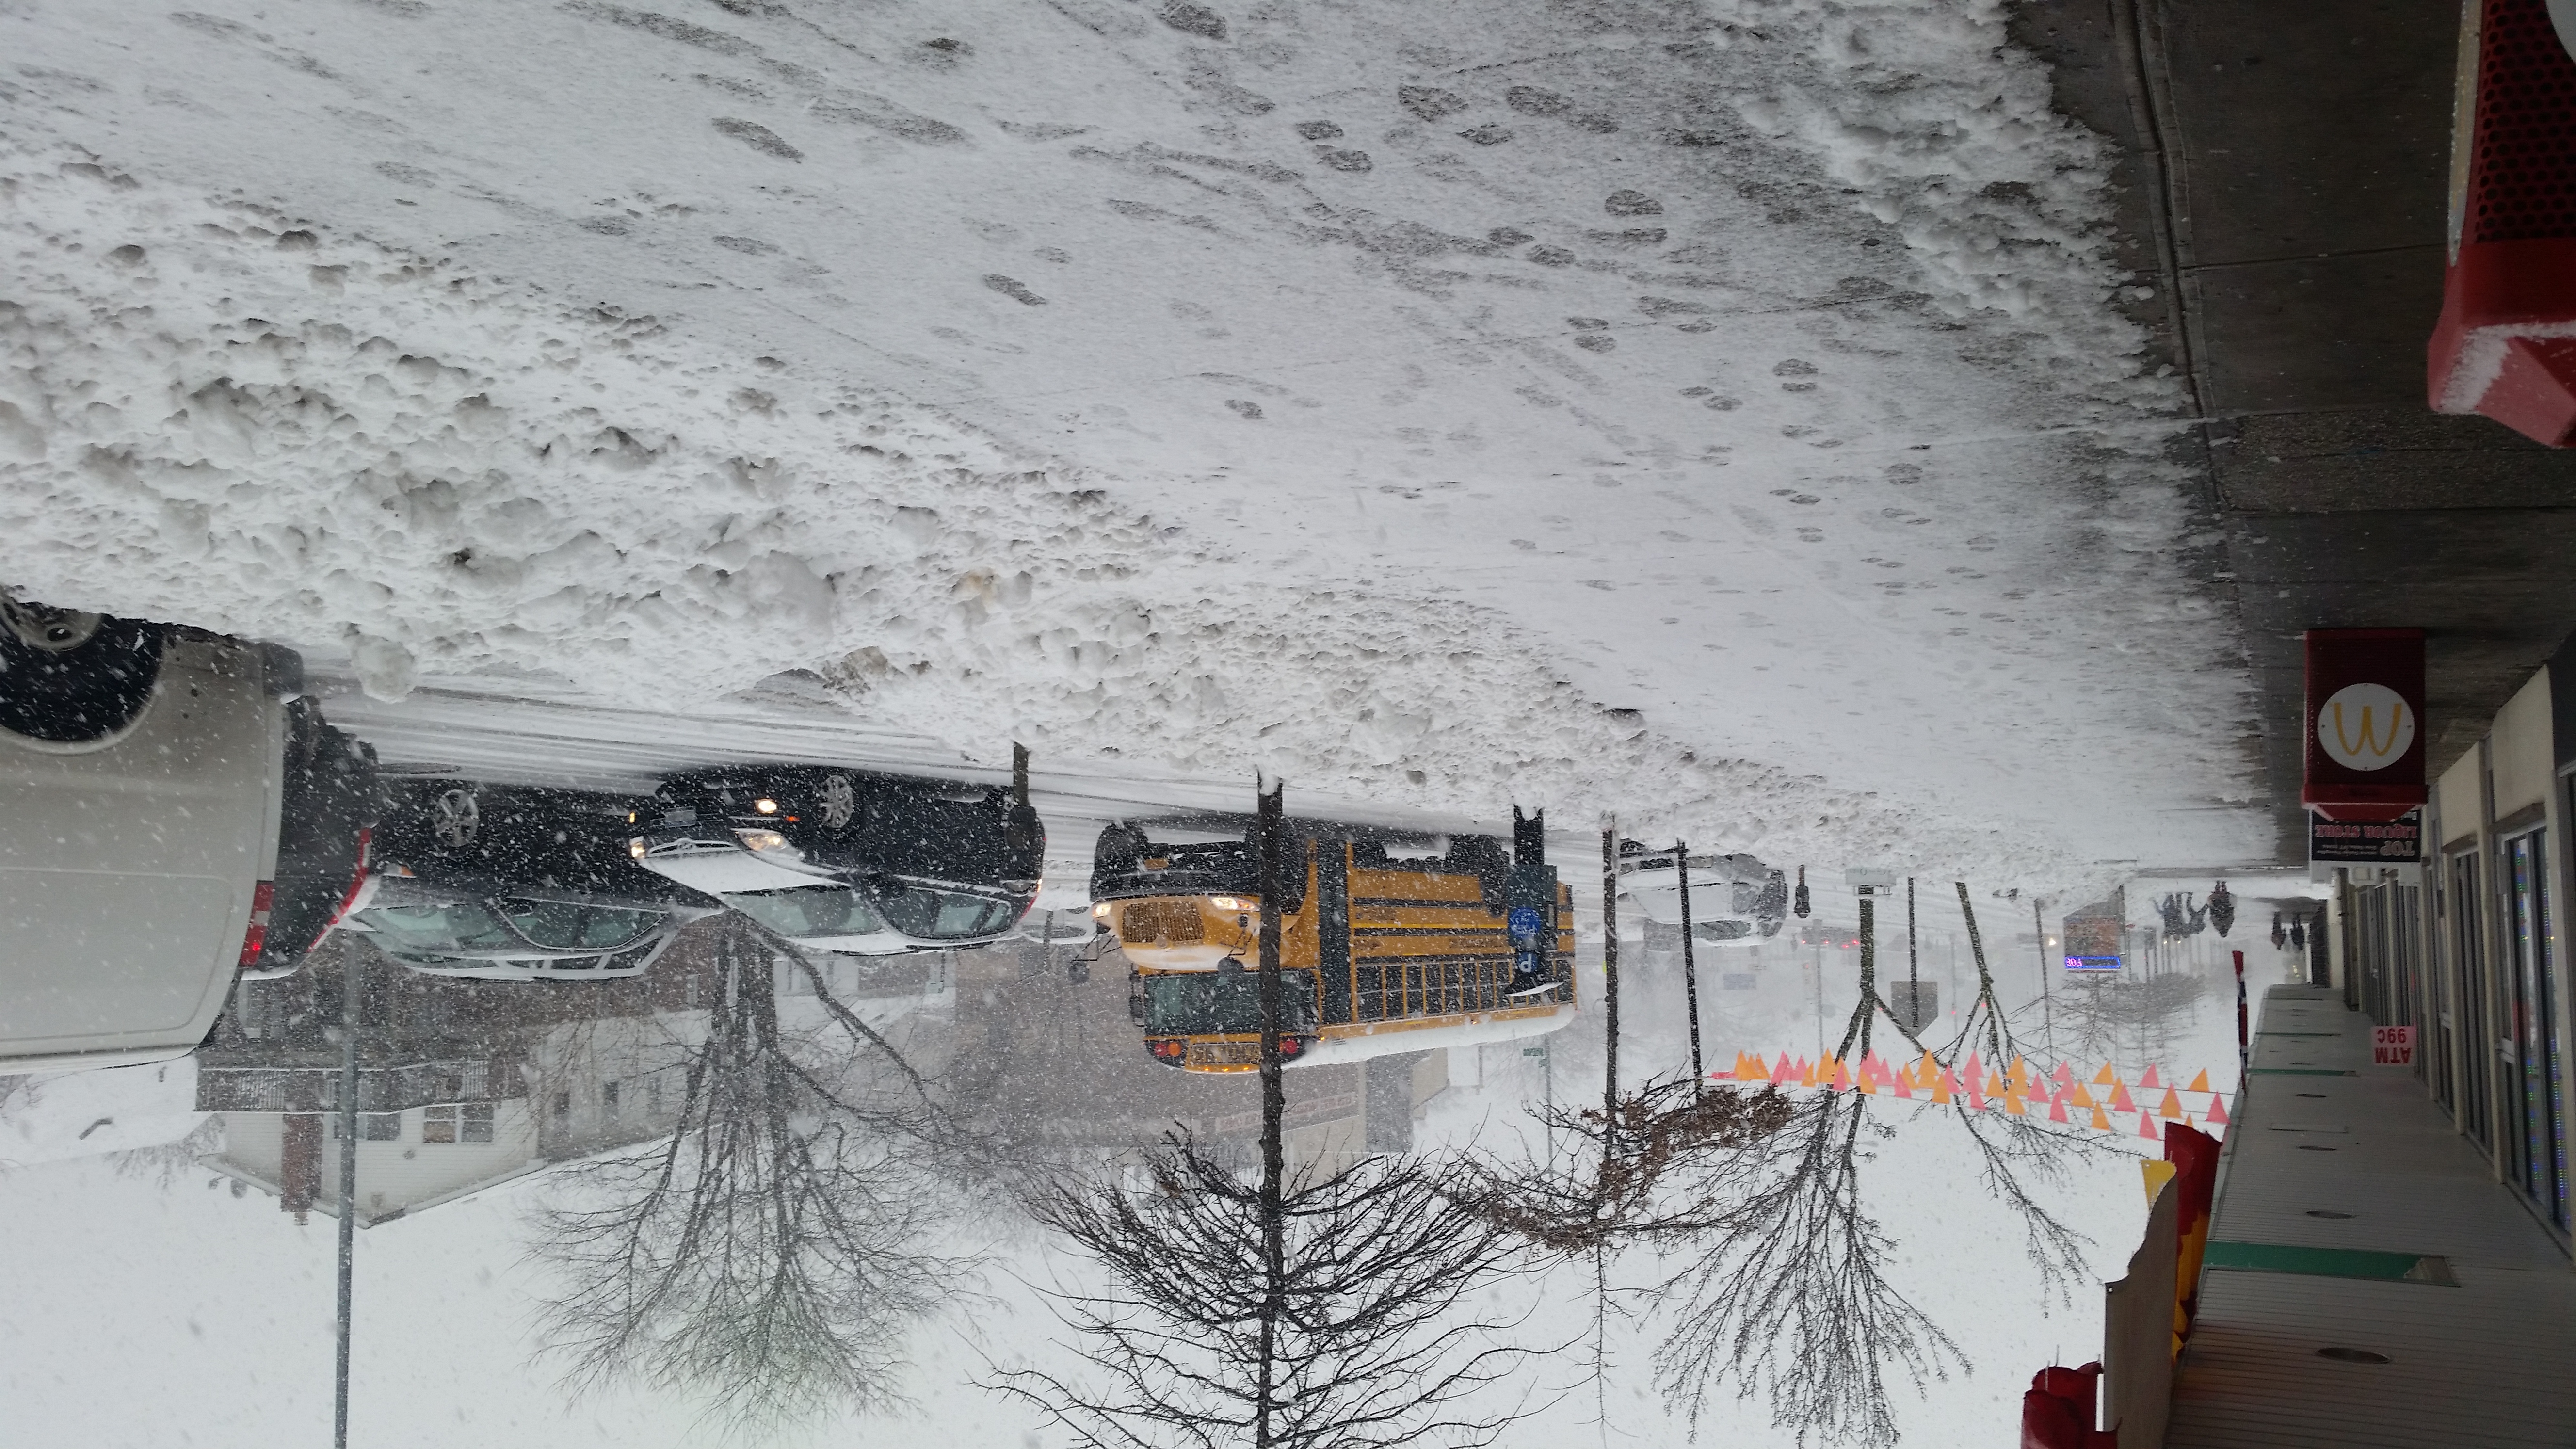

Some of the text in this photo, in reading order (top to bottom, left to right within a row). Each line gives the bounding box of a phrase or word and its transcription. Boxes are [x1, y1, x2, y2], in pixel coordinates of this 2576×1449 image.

[2315, 823, 2417, 839] LIQUOR STORE
[2380, 840, 2415, 856] TOP
[1519, 953, 1532, 973] P
[2375, 1047, 2411, 1064] ATM
